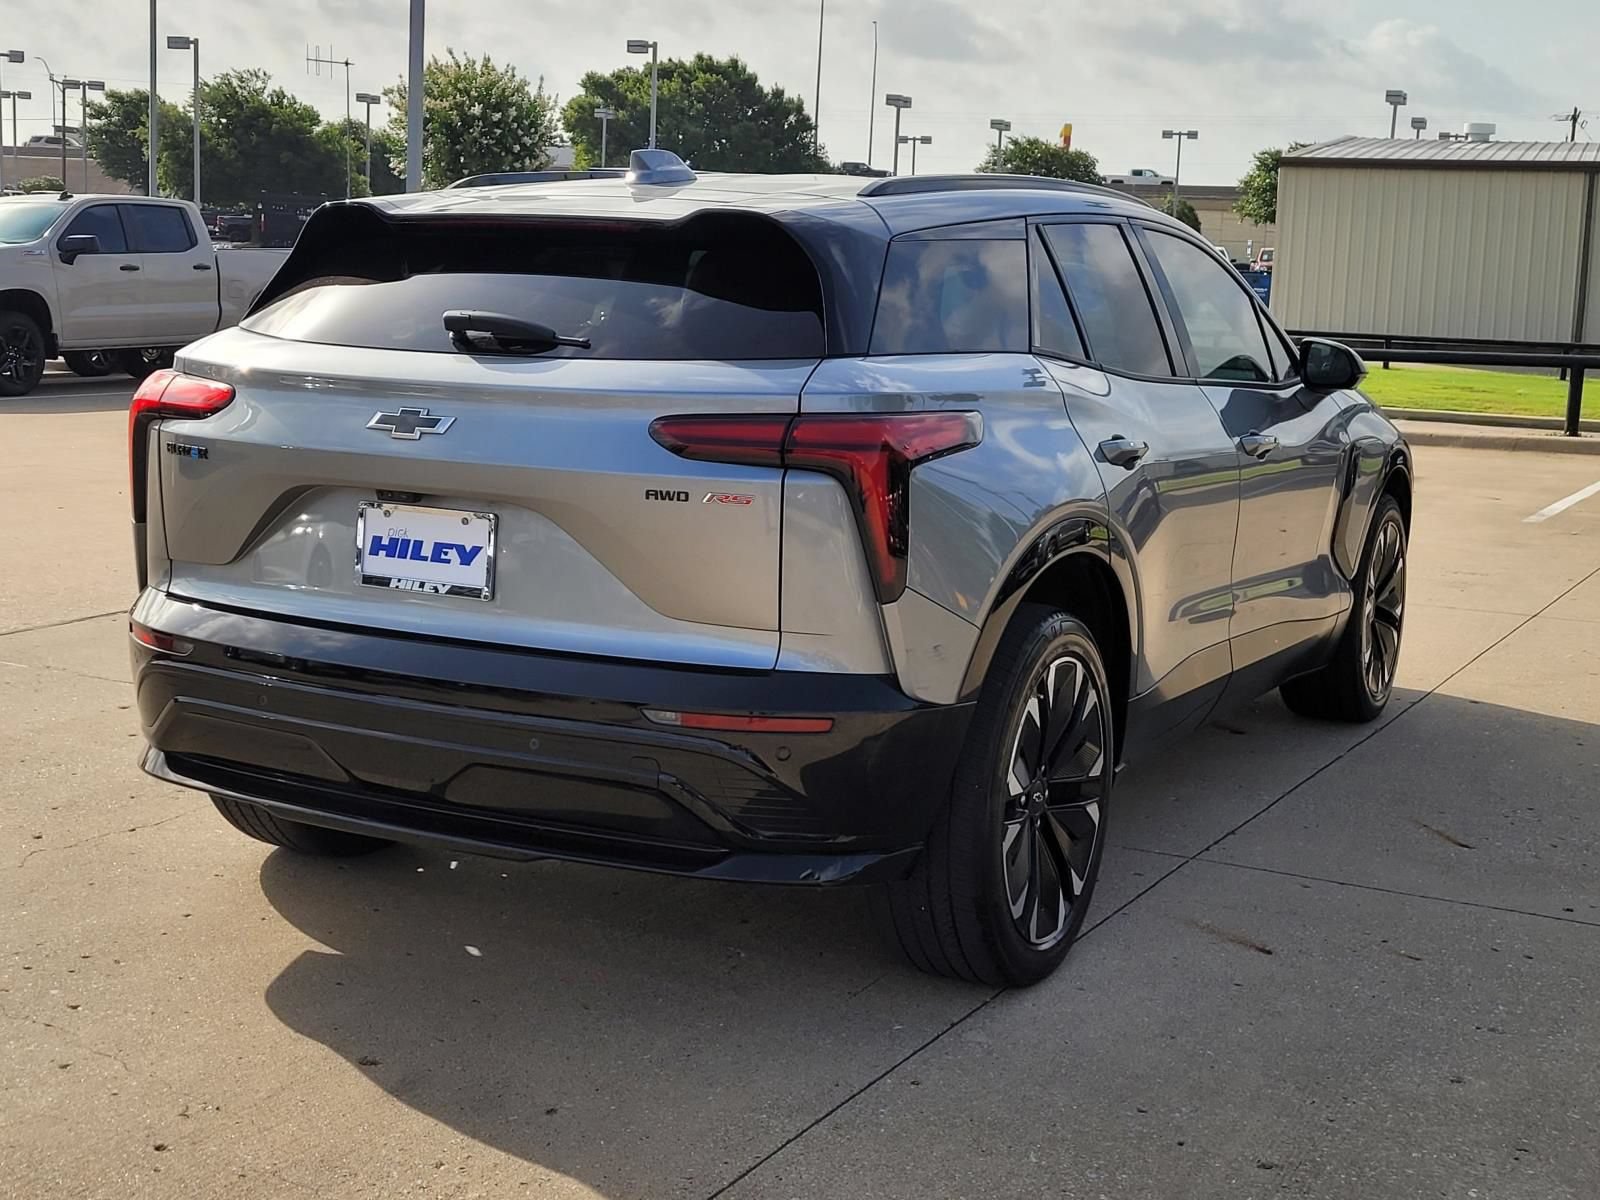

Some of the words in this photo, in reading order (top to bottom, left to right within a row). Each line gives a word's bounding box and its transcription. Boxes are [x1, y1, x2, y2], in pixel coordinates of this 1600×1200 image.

[645, 489, 690, 502] AWD
[703, 492, 754, 505] RS
[368, 535, 483, 566] HILEY
[389, 578, 452, 594] HILEY
